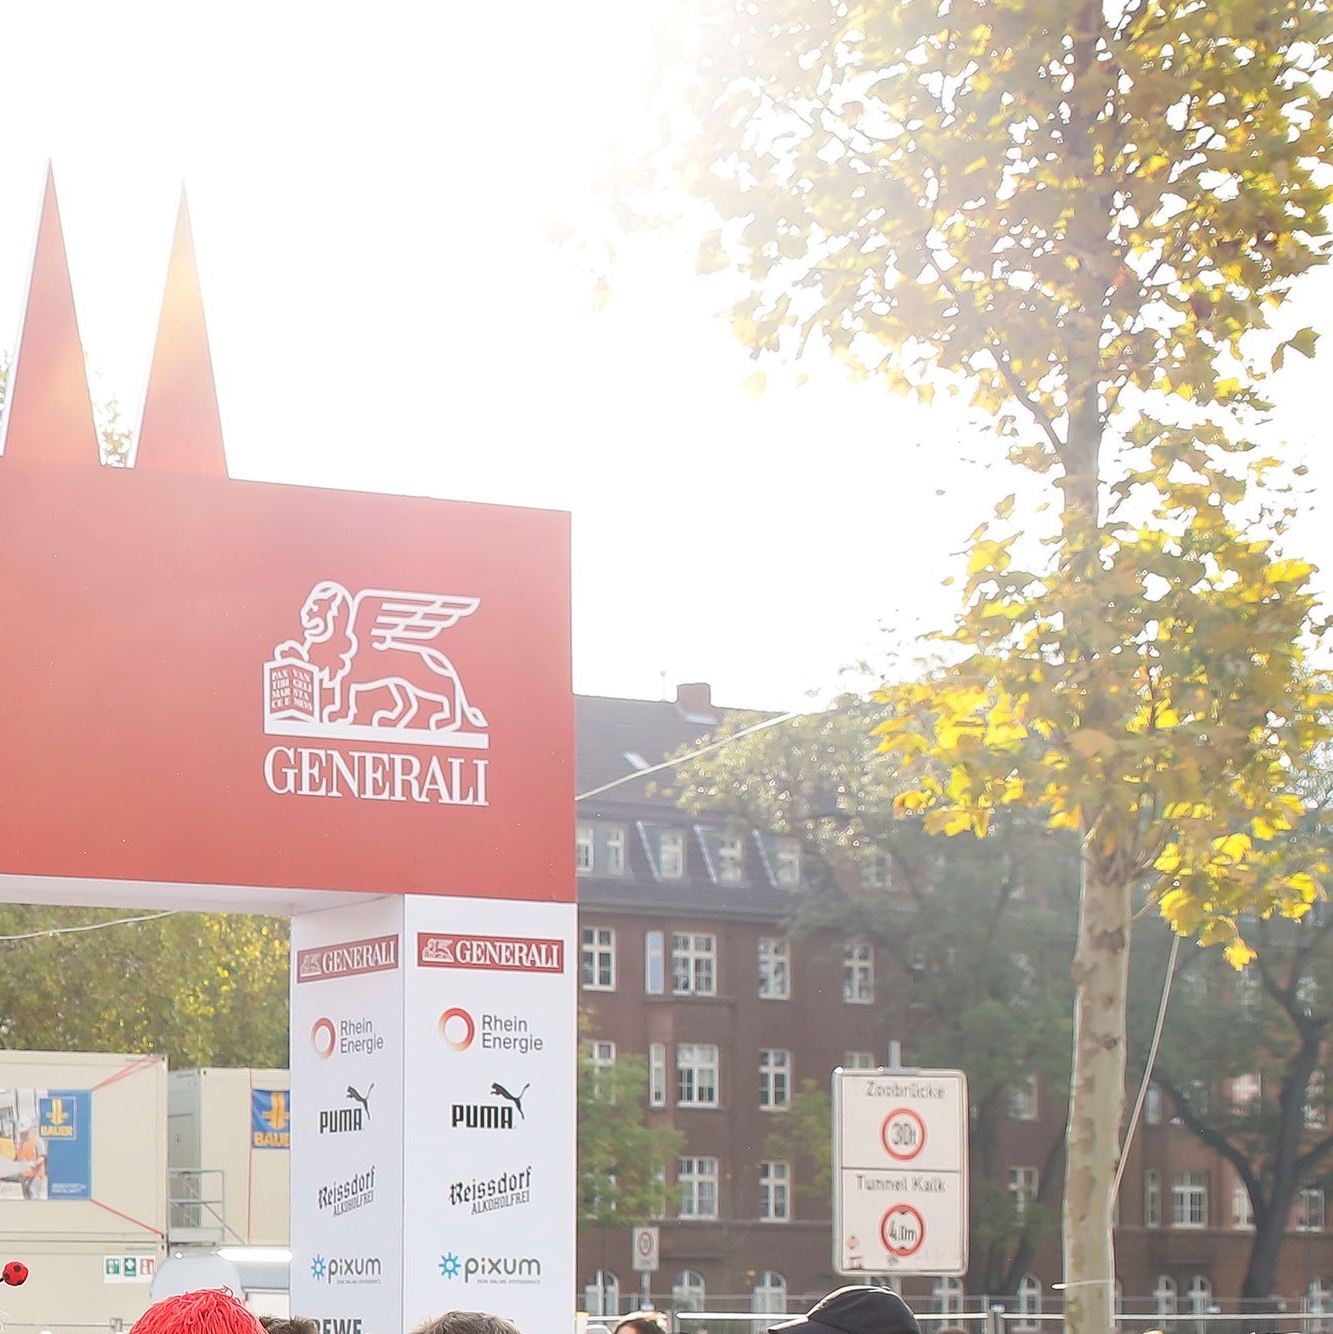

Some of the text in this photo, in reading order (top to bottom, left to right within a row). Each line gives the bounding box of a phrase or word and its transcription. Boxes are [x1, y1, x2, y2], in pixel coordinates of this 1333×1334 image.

[263, 746, 490, 806] GENERALI
[321, 940, 396, 974] GENERALI
[455, 940, 559, 968] GENERALI
[339, 1018, 373, 1035] Rhein
[482, 1015, 528, 1033] Rhein
[339, 1034, 384, 1054] Energie
[482, 1033, 543, 1053] Energie
[866, 1081, 946, 1099] Zoobrücke
[319, 1108, 362, 1134] PUMA
[451, 1104, 514, 1130] PUMA
[40, 1126, 74, 1137] BAUER
[254, 1132, 290, 1147] BAUE
[317, 1165, 376, 1209] Reissdorf
[449, 1165, 532, 1206] Reissdorf
[856, 1176, 946, 1192] Tunnel Kalk
[333, 1190, 374, 1217] ALKOHOLFREI
[471, 1190, 530, 1216] ALKOHOLFREI
[327, 1256, 382, 1284] pixum
[464, 1257, 542, 1283] pixum
